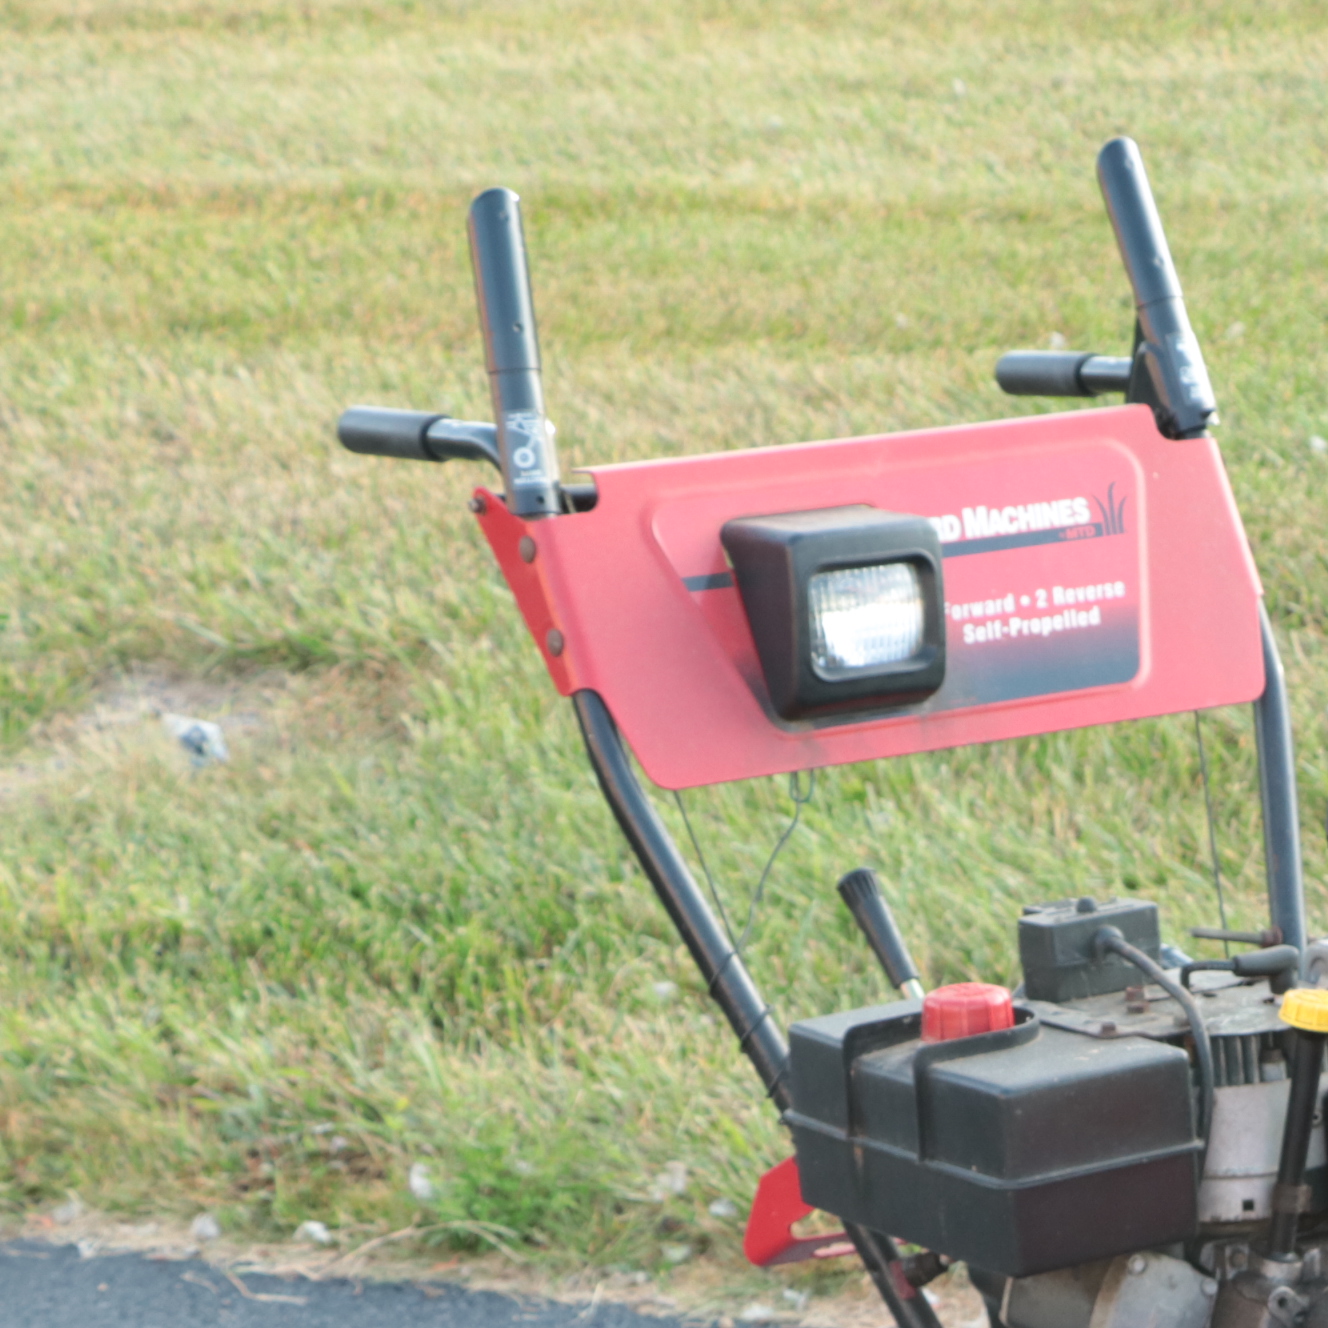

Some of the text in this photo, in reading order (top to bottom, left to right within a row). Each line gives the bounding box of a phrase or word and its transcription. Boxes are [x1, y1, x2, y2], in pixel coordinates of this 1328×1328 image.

[961, 496, 1092, 539] MACHINES
[1035, 588, 1049, 609] 2
[1052, 581, 1126, 606] Reverse
[963, 605, 1101, 644] Self-Propelled
